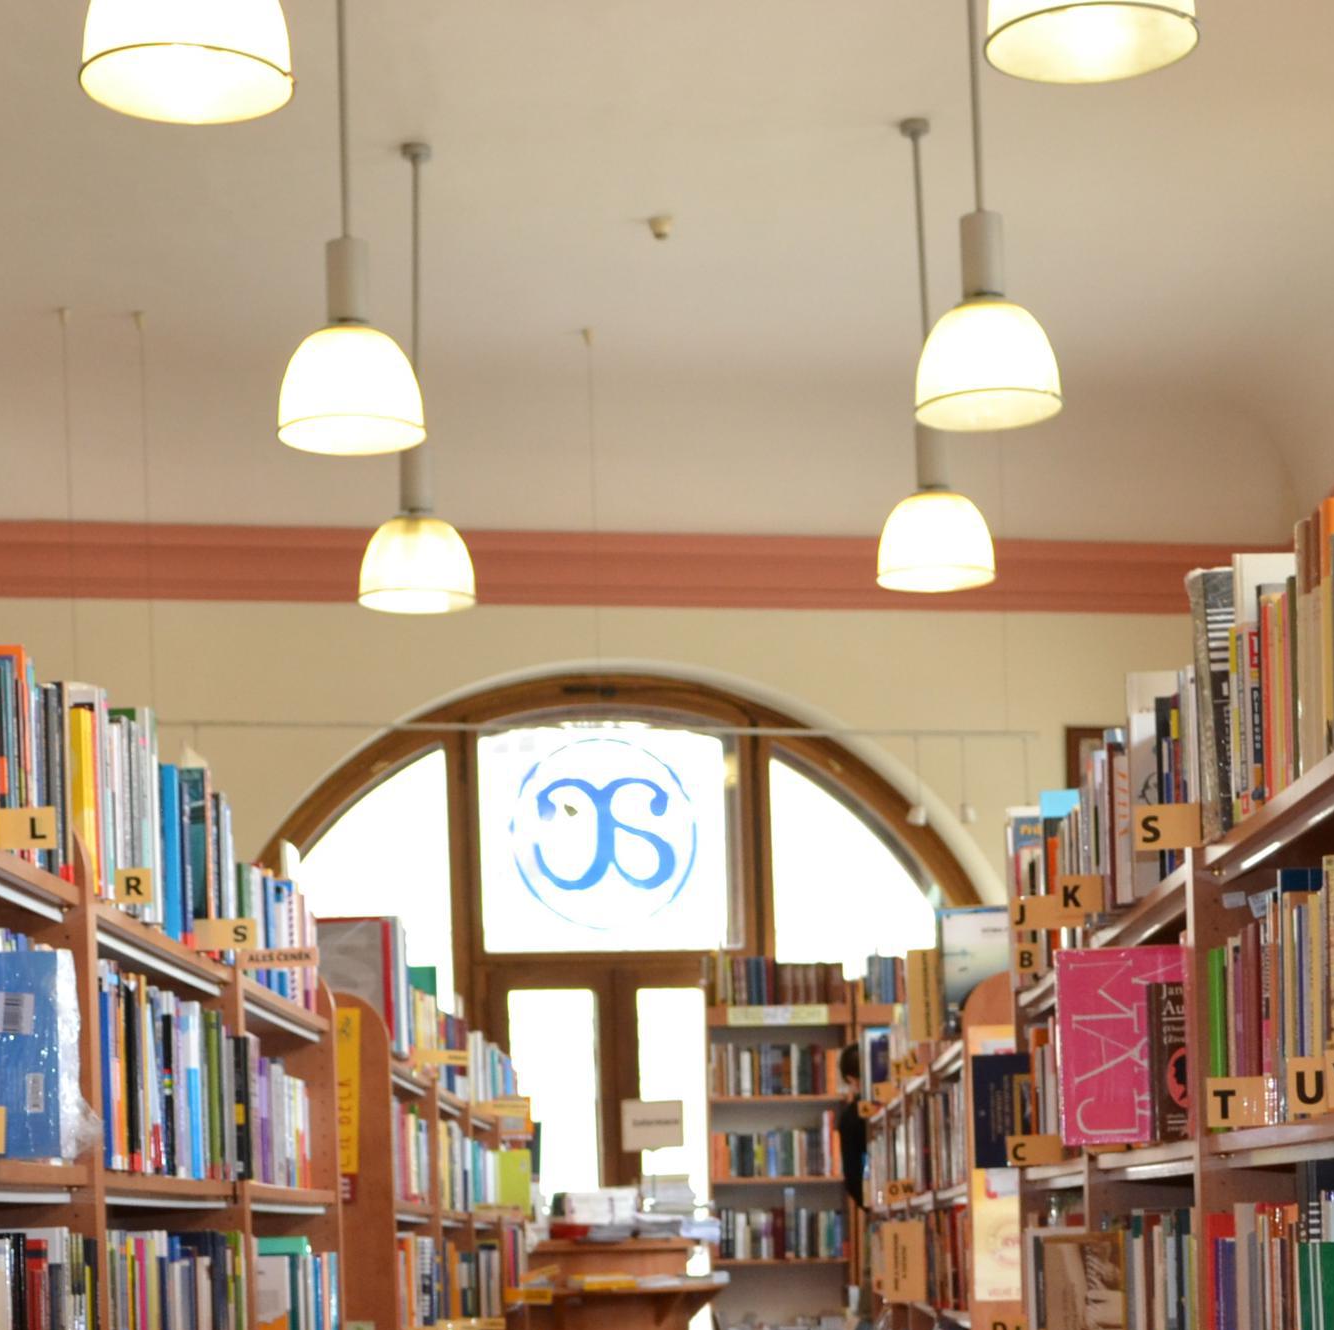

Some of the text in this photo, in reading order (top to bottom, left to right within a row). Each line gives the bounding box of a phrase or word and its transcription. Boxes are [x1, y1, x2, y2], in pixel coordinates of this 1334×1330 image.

[30, 819, 46, 840] L
[1141, 818, 1160, 843] S
[125, 876, 143, 897] R
[1061, 886, 1080, 908] K
[1013, 905, 1024, 925] J
[234, 926, 247, 944] S
[1020, 952, 1033, 968] B
[1297, 1072, 1323, 1103] U
[1214, 1090, 1236, 1120] T
[1012, 1144, 1026, 1162] C
